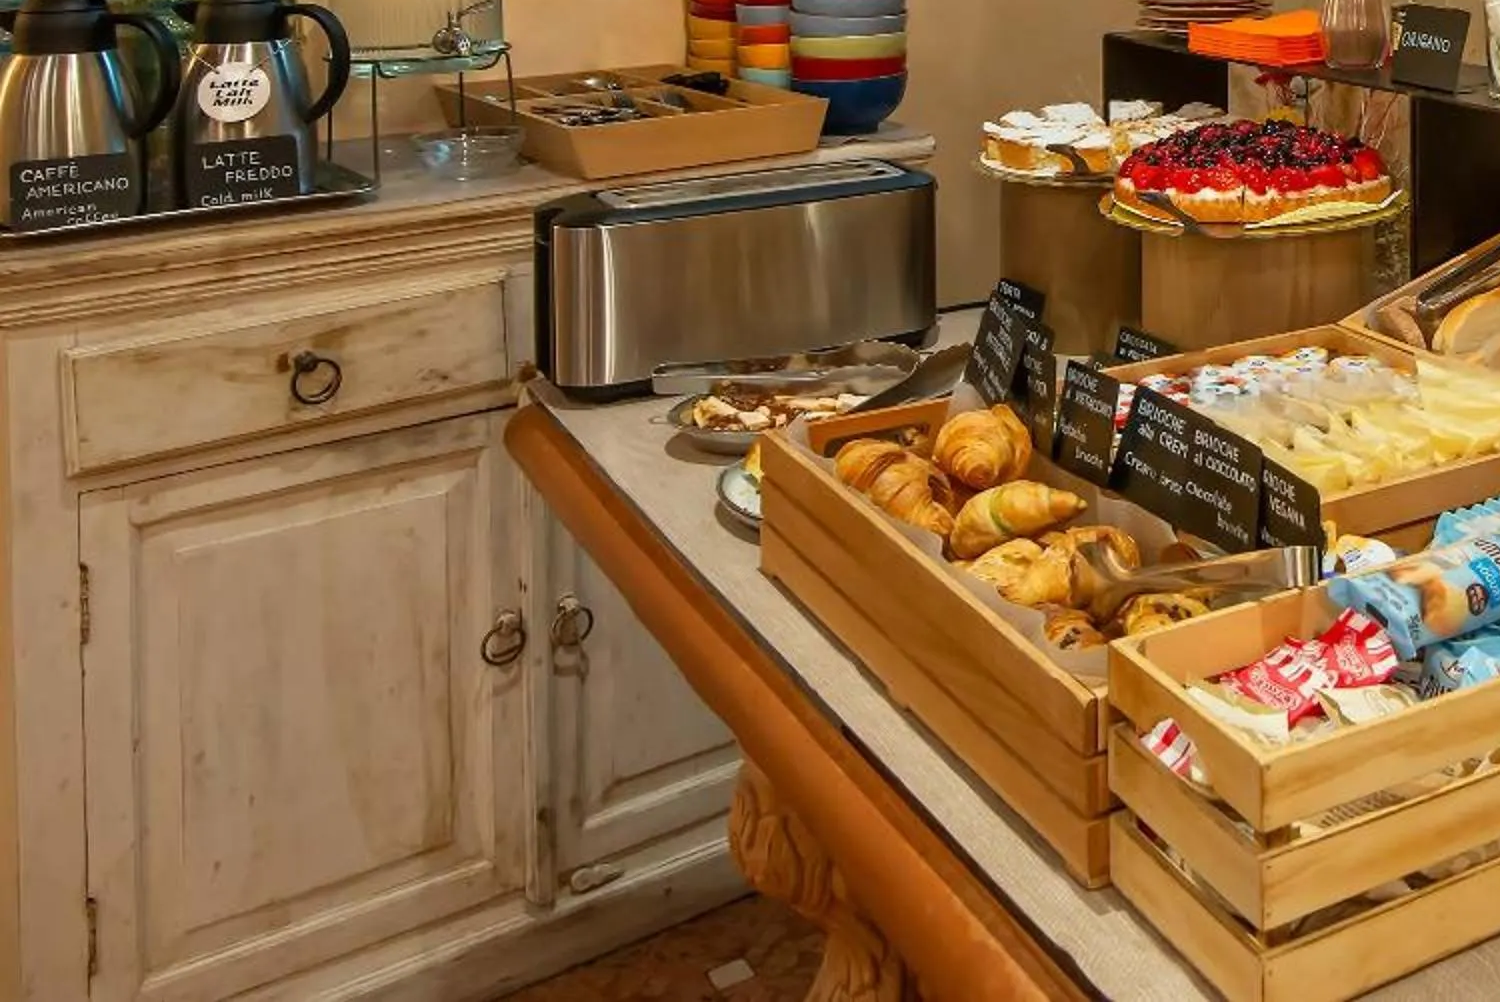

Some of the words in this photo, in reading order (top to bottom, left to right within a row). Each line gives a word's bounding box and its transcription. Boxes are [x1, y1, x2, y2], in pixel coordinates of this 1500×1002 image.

[202, 151, 262, 170] LATTE
[225, 165, 293, 183] FREDDO
[25, 177, 129, 200] AMERICANO
[201, 191, 234, 207] Cold
[21, 203, 97, 221] American
[1137, 399, 1186, 435] BRIOCHE
[1194, 430, 1240, 463] BRIOCHE
[1205, 456, 1257, 493] CIOCCOLATO
